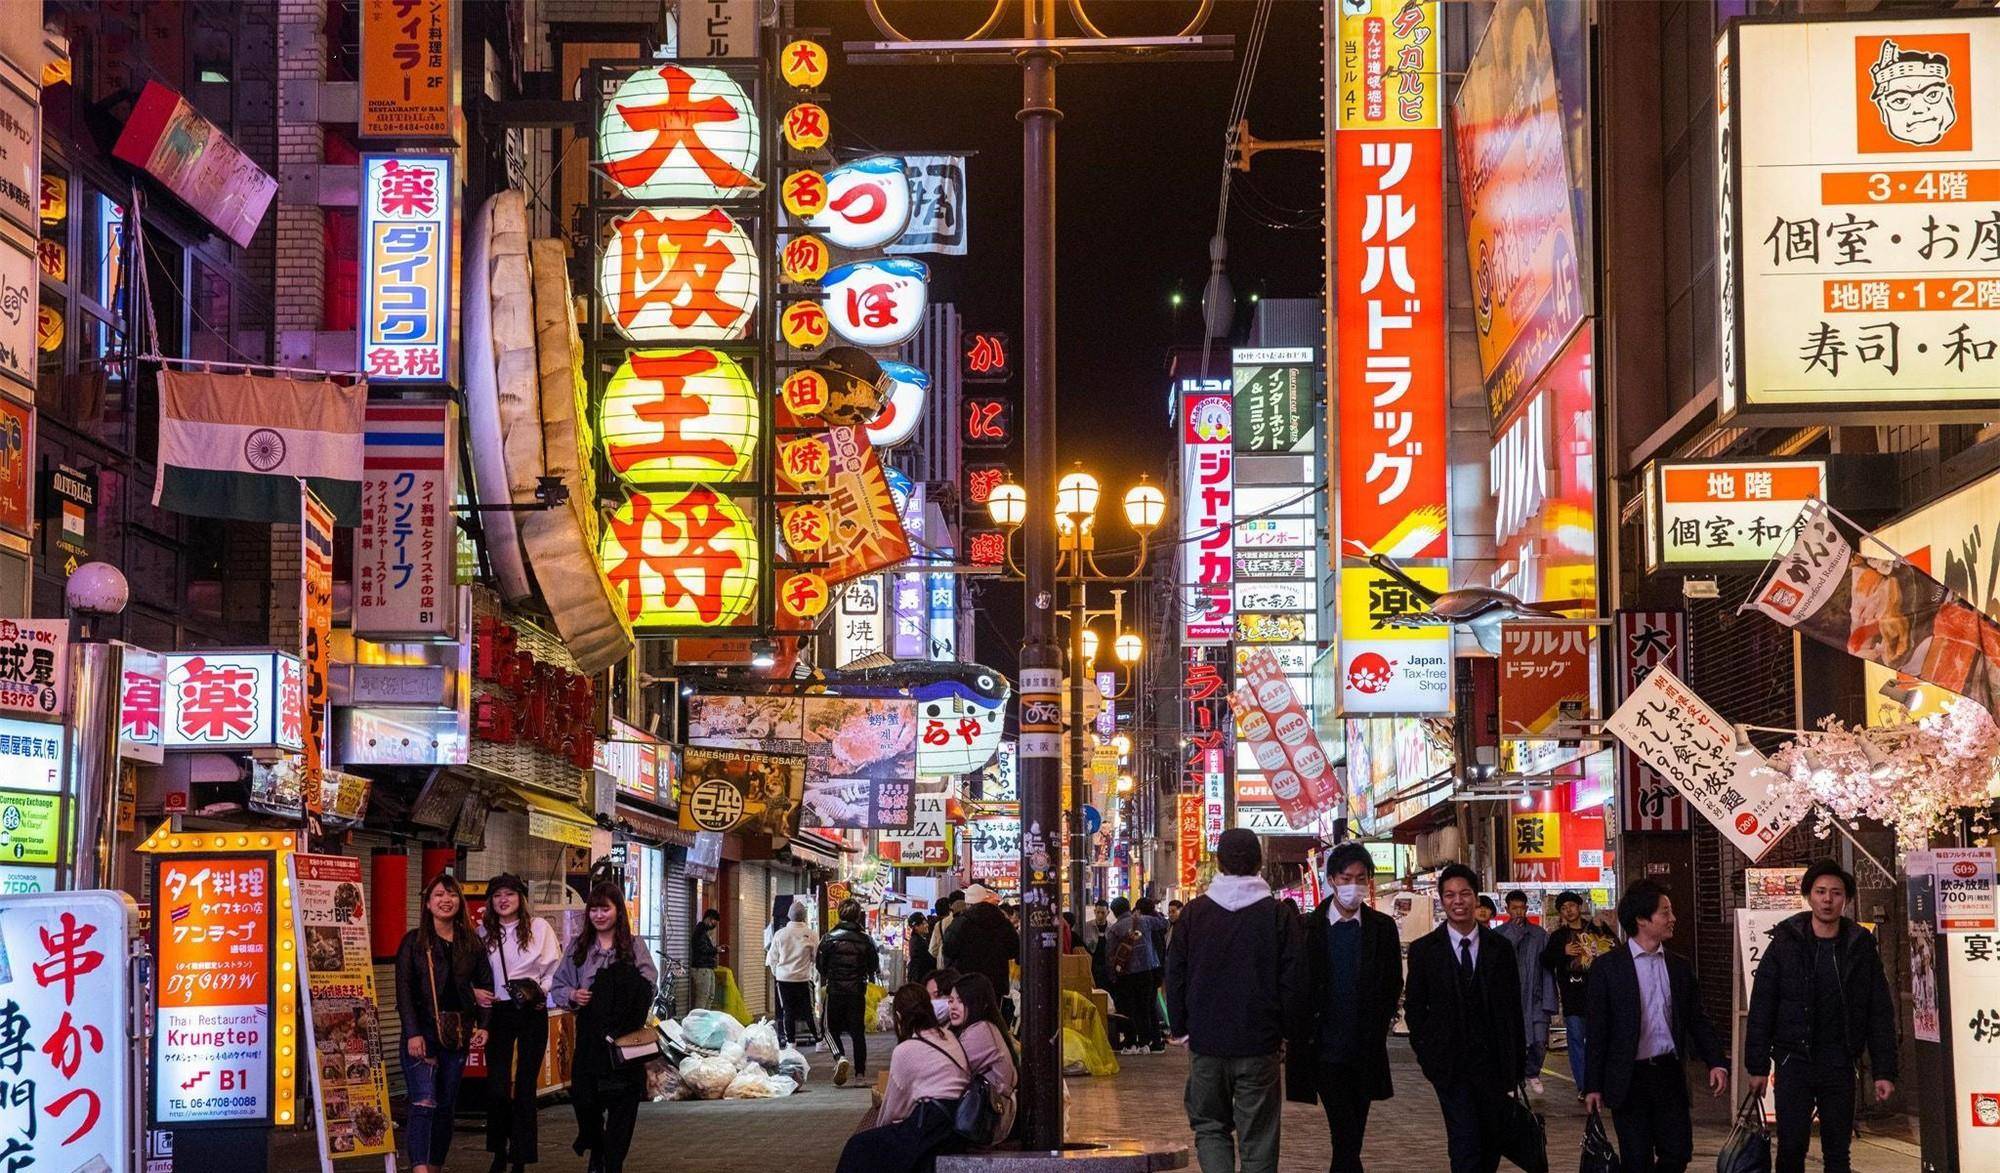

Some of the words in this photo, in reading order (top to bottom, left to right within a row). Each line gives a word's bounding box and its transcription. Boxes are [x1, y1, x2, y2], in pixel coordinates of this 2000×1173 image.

[706, 0, 731, 56] ービル
[427, 77, 443, 88] 2F
[379, 163, 440, 217] 薬
[1867, 172, 1967, 202] 3・4階
[379, 226, 434, 342] ダイコク
[1360, 143, 1423, 505] ツルハドラッグ
[597, 64, 766, 622] 大阪王将
[368, 347, 441, 377] 免税
[1250, 382, 1265, 450] &コミック
[1269, 368, 1284, 450] インターネット
[1707, 472, 1773, 499] 地階
[393, 473, 415, 590] クンテープ
[1199, 450, 1231, 622] ジャンカラ
[1245, 532, 1299, 544] レインボー
[1369, 579, 1422, 631] 薬
[1506, 631, 1587, 655] ツルハ
[1407, 655, 1447, 666] Japan.
[1507, 660, 1572, 678] ドラッグ
[1403, 669, 1447, 679] Tax-free
[1419, 680, 1447, 691] Shop
[183, 669, 254, 738] 薬
[1261, 684, 1287, 703] CAFE
[923, 717, 982, 746] らや
[1244, 716, 1266, 732] CAFE
[1277, 717, 1304, 737] INFO
[686, 749, 740, 762] MAMESHIBA
[743, 754, 769, 764] CAFE
[771, 757, 805, 767] OSAKA
[1297, 750, 1321, 768] LIVE
[1274, 774, 1296, 791] LIVE
[26, 797, 53, 809] Exchange
[1250, 814, 1288, 828] ZAZ
[1517, 818, 1544, 854] 薬
[925, 846, 944, 859] 2F
[1954, 864, 1976, 875] 60分
[165, 867, 264, 901] タイ料理
[1940, 879, 1990, 891] 飲み放題
[1964, 934, 2000, 962] 宴
[33, 912, 105, 1147] 串かつ
[170, 1015, 192, 1027] Thai
[198, 1013, 259, 1026] Restaurant
[168, 1027, 260, 1048] Krungtep
[219, 1068, 247, 1091] B1
[169, 1099, 187, 1110] TEL
